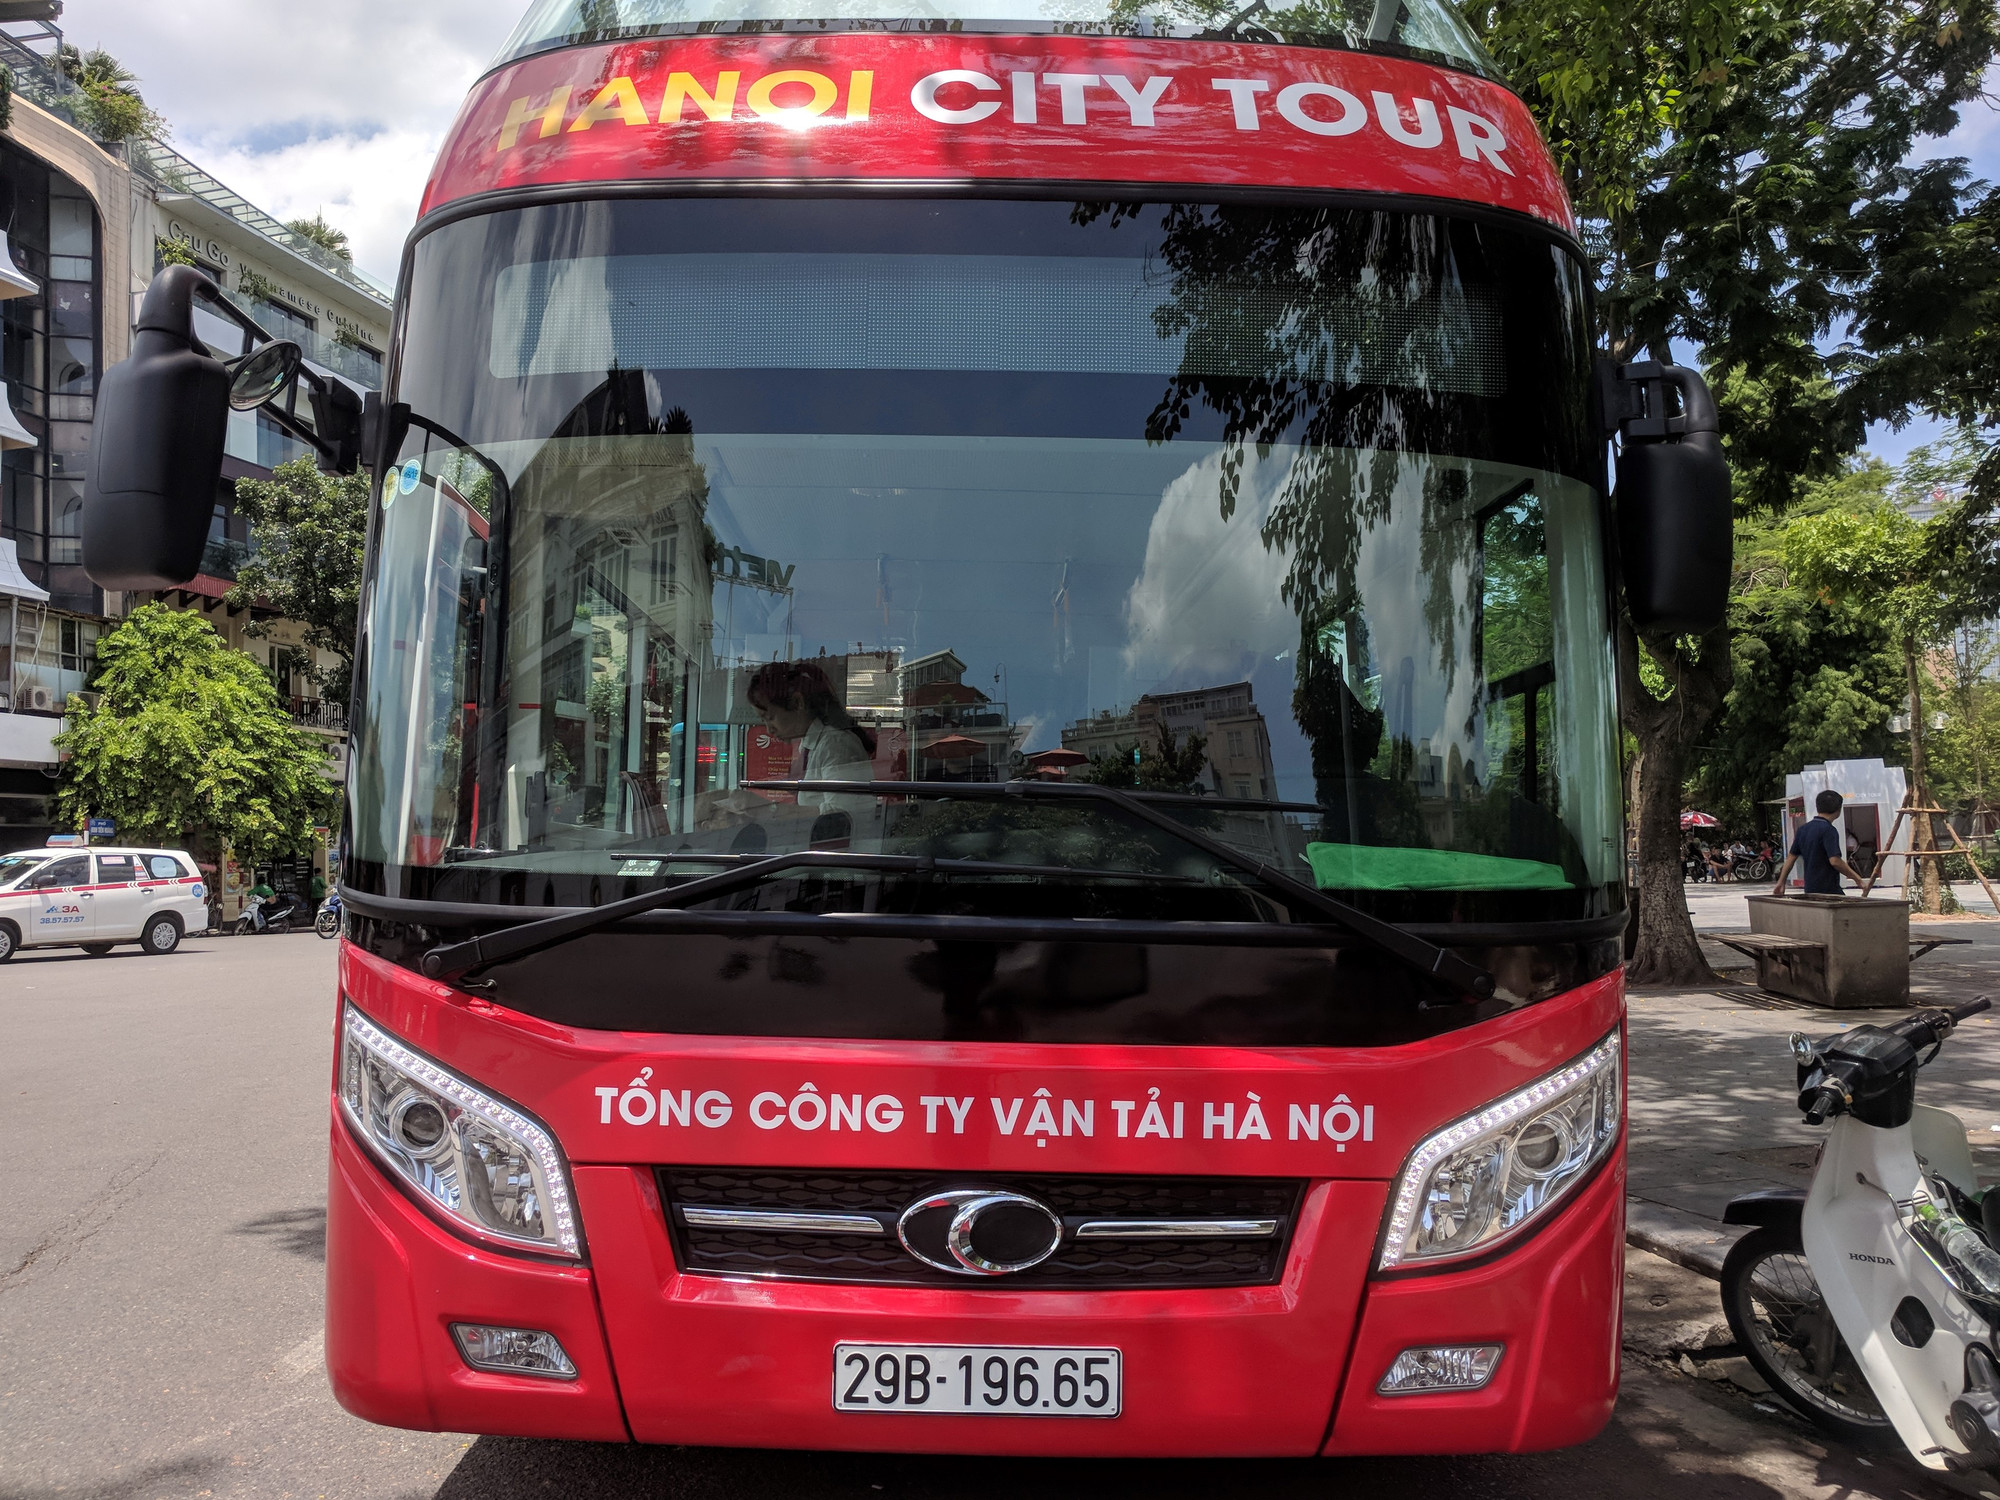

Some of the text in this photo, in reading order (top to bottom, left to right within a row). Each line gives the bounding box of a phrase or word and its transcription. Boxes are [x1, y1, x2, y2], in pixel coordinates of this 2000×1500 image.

[497, 69, 1515, 177] HANOI CITY TOUR
[168, 219, 230, 267] Cau Go
[40, 916, 85, 925] 38.57.57.57
[62, 905, 80, 914] 3A
[595, 1066, 1374, 1153] TỔNG CÔNG TY VẬN TẢI HÀ NỘI
[1849, 1252, 1896, 1266] HONDA
[843, 1351, 1110, 1409] 29B-196.65
